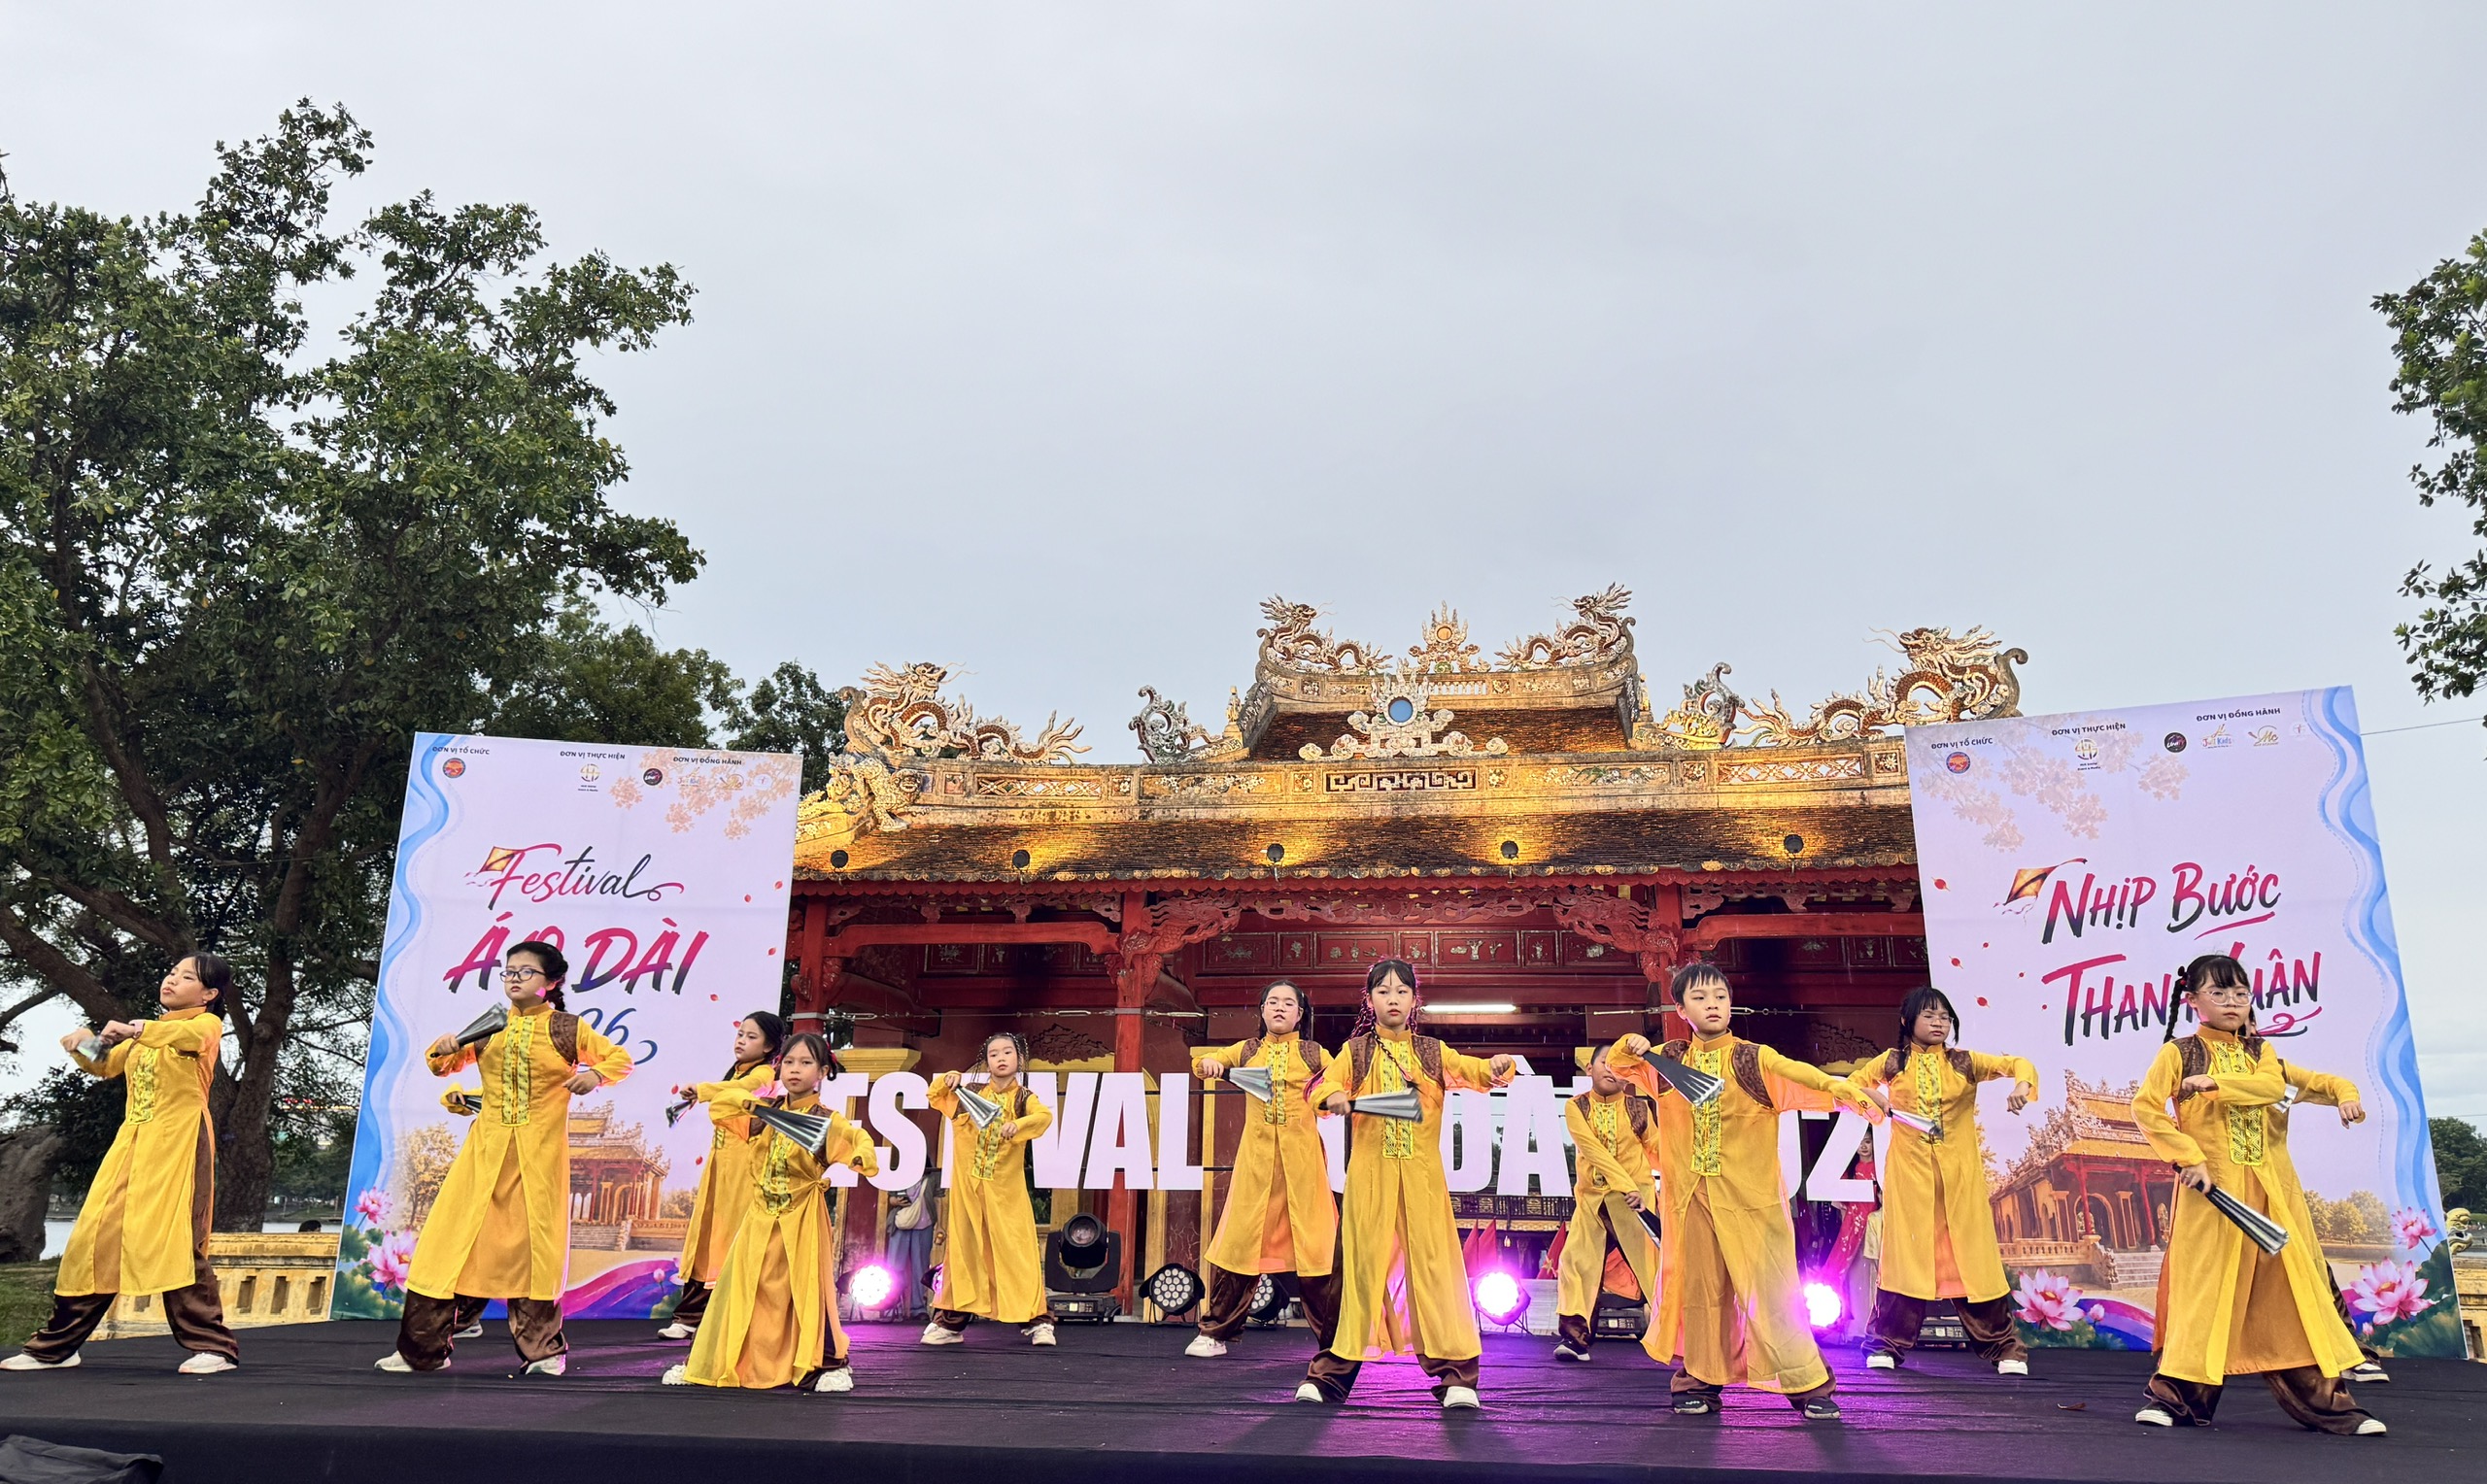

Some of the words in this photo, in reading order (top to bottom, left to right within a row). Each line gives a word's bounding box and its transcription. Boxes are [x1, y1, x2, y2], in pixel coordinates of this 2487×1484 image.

[2081, 725, 2105, 733] THỰC
[2106, 722, 2126, 731] HIỆN
[1971, 736, 1993, 745] CHỨC
[607, 752, 626, 760] HIỆN
[488, 843, 684, 911] Festival
[571, 917, 709, 995] DÀI
